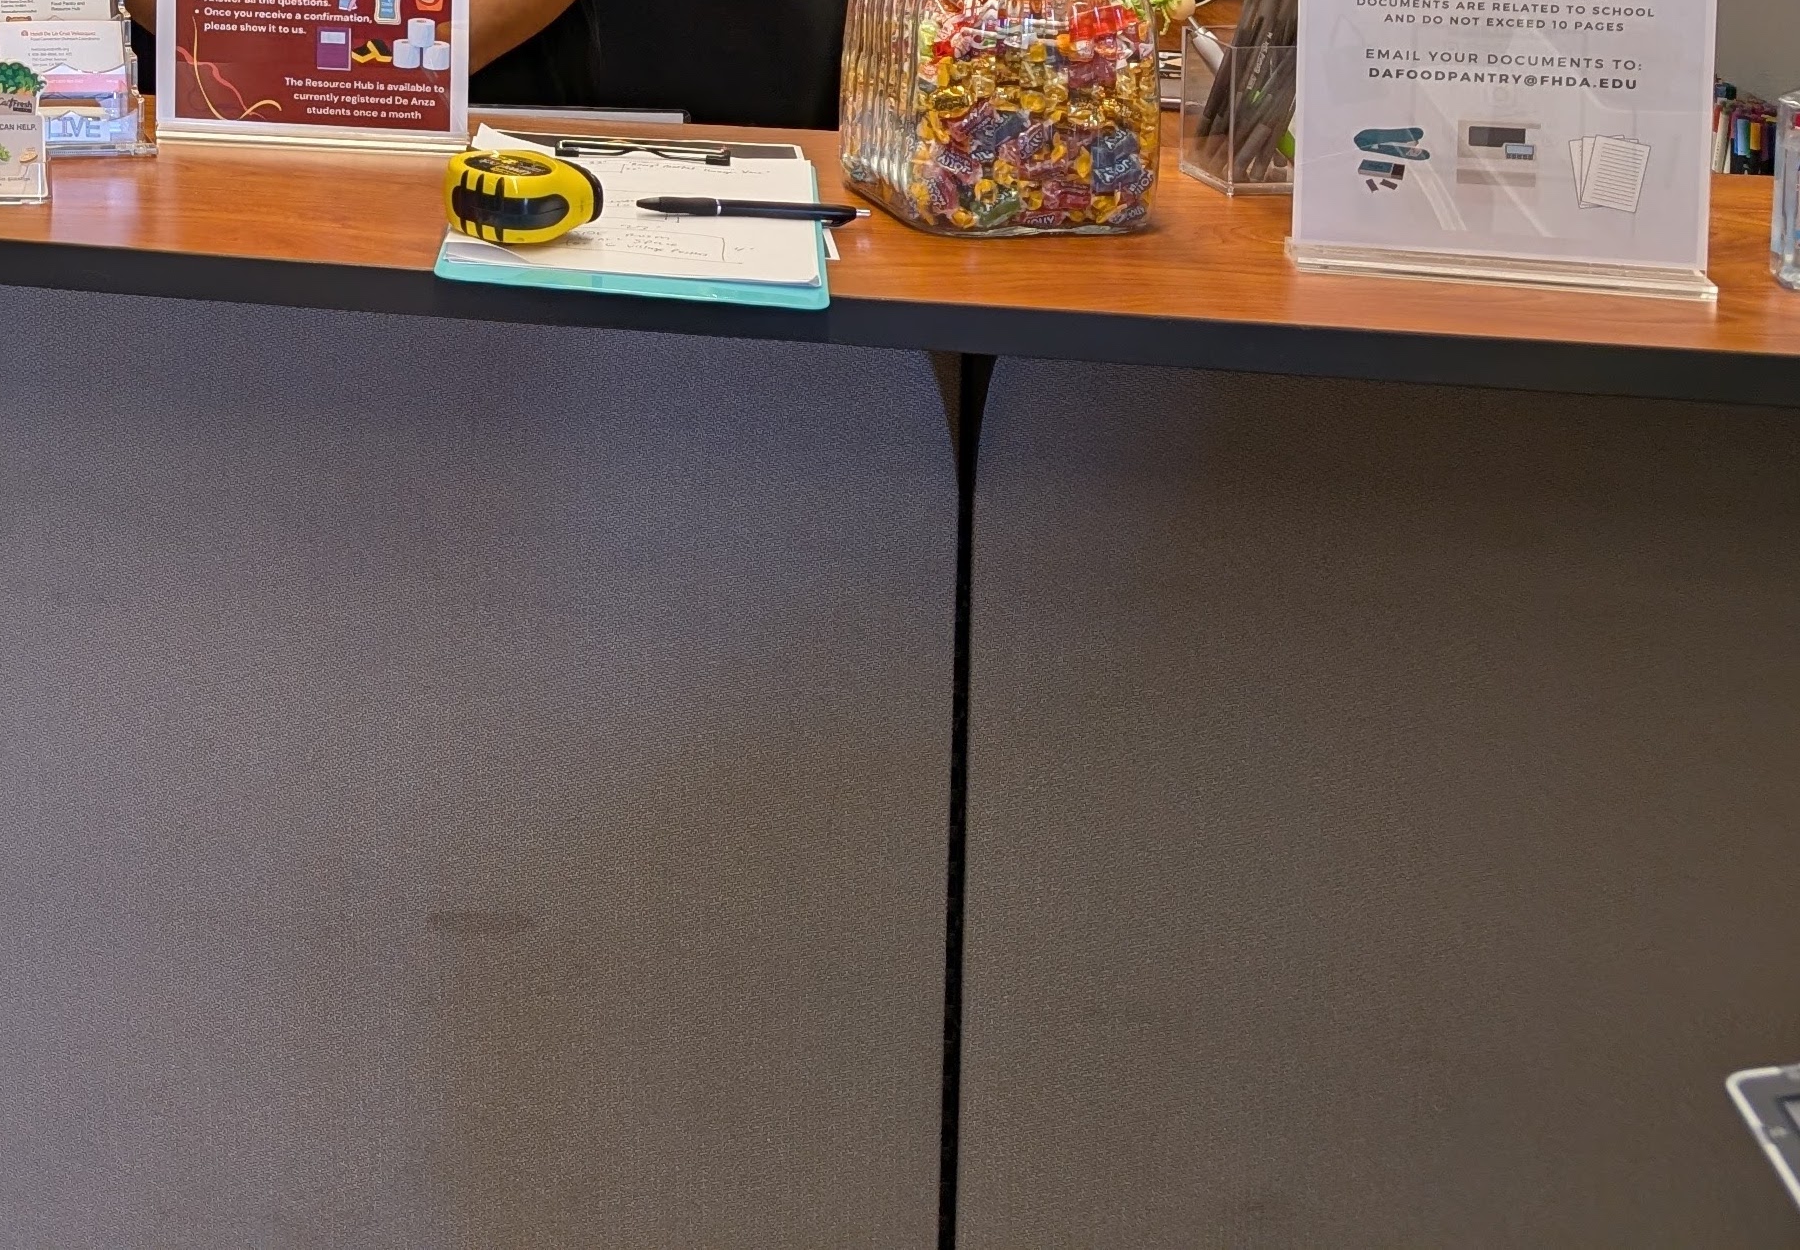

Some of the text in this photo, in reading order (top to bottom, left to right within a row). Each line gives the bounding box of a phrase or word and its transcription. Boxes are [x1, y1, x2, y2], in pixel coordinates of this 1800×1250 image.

[204, 7, 231, 17] Once
[234, 10, 252, 19] you
[255, 10, 293, 20] receive
[304, 12, 372, 24] confirmation,
[1456, 1, 1485, 11] ARE
[1492, 2, 1560, 14] RELATED
[1566, 5, 1586, 15] TO
[1592, 6, 1655, 17] SCHOOL
[204, 22, 237, 32] please
[240, 23, 267, 32] show
[269, 24, 276, 33] it
[278, 25, 291, 34] to
[1384, 13, 1624, 32] AND DO NOT EXCEED 10 PAGES
[1366, 48, 1642, 71] EMAIL YOUR DOCUMENTS TO:
[285, 77, 444, 93] The Resource Hub is available to
[1369, 67, 1637, 90] DAFOODPANTRY@FHDA.EDU
[294, 93, 436, 106] currently registered De Anza
[307, 107, 351, 116] students
[353, 109, 378, 117] once
[389, 110, 422, 119] month
